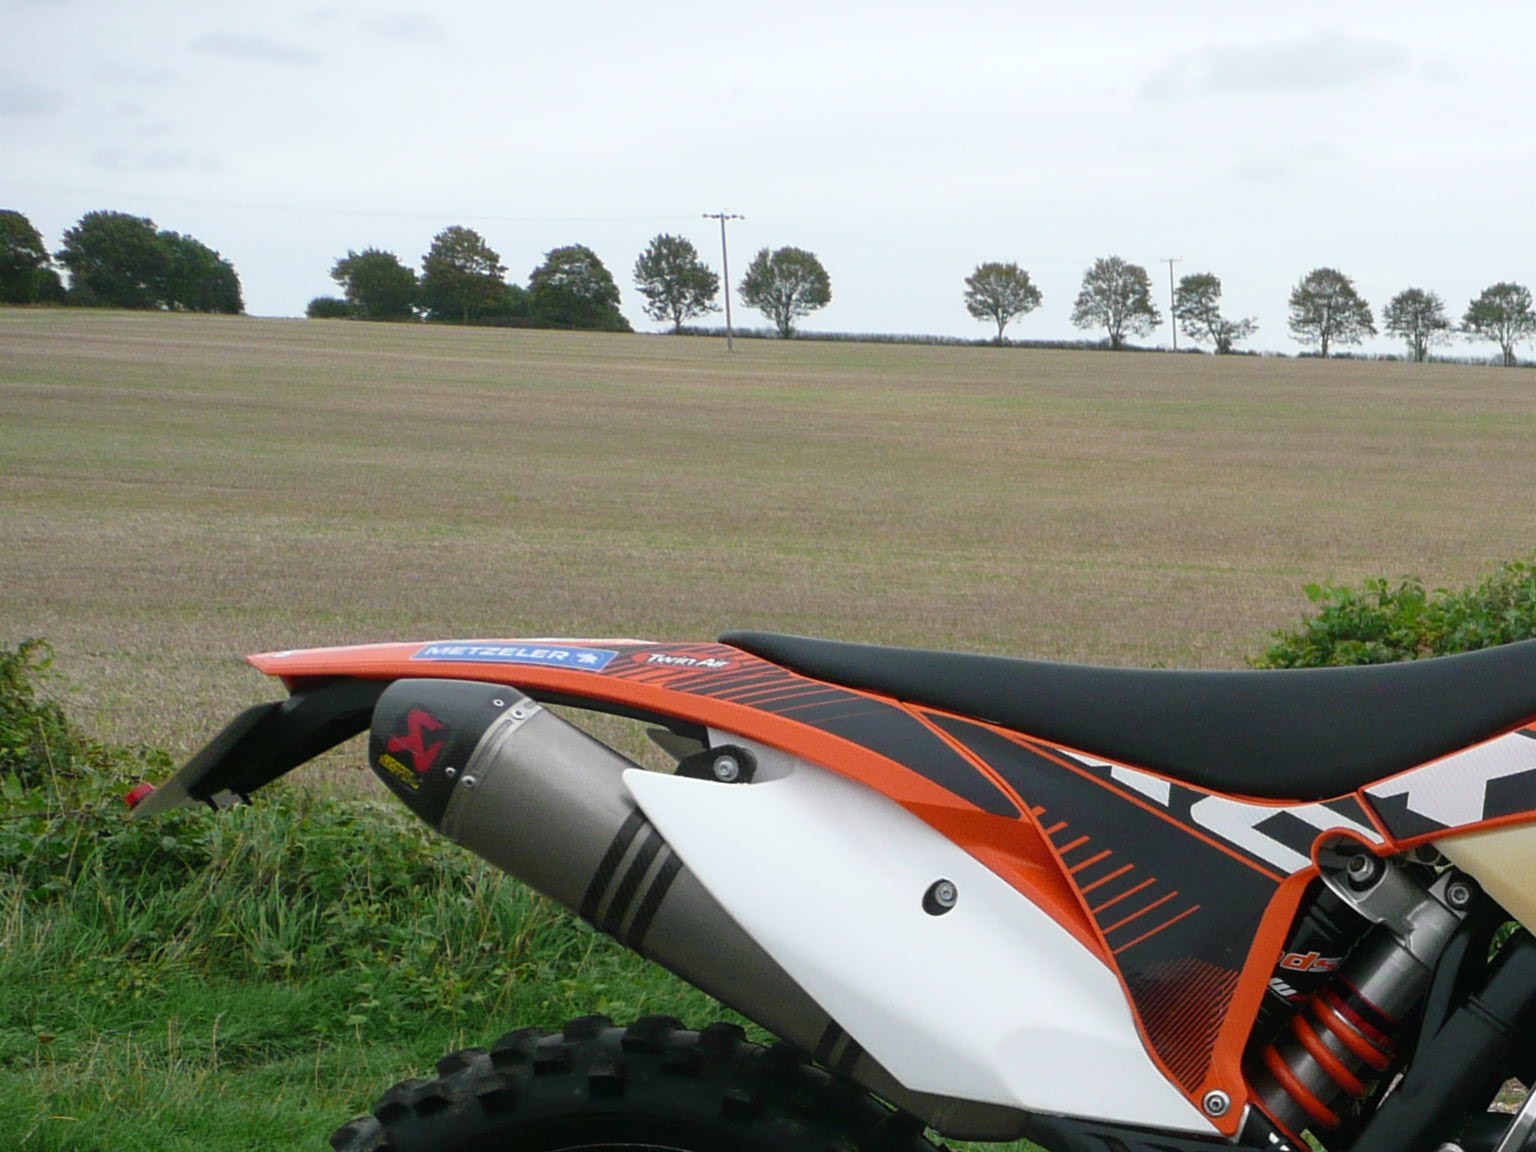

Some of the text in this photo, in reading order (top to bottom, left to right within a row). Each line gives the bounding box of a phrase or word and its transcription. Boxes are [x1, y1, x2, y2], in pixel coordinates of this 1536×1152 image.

[424, 646, 571, 661] METZELER
[647, 653, 731, 669] Twin Air
